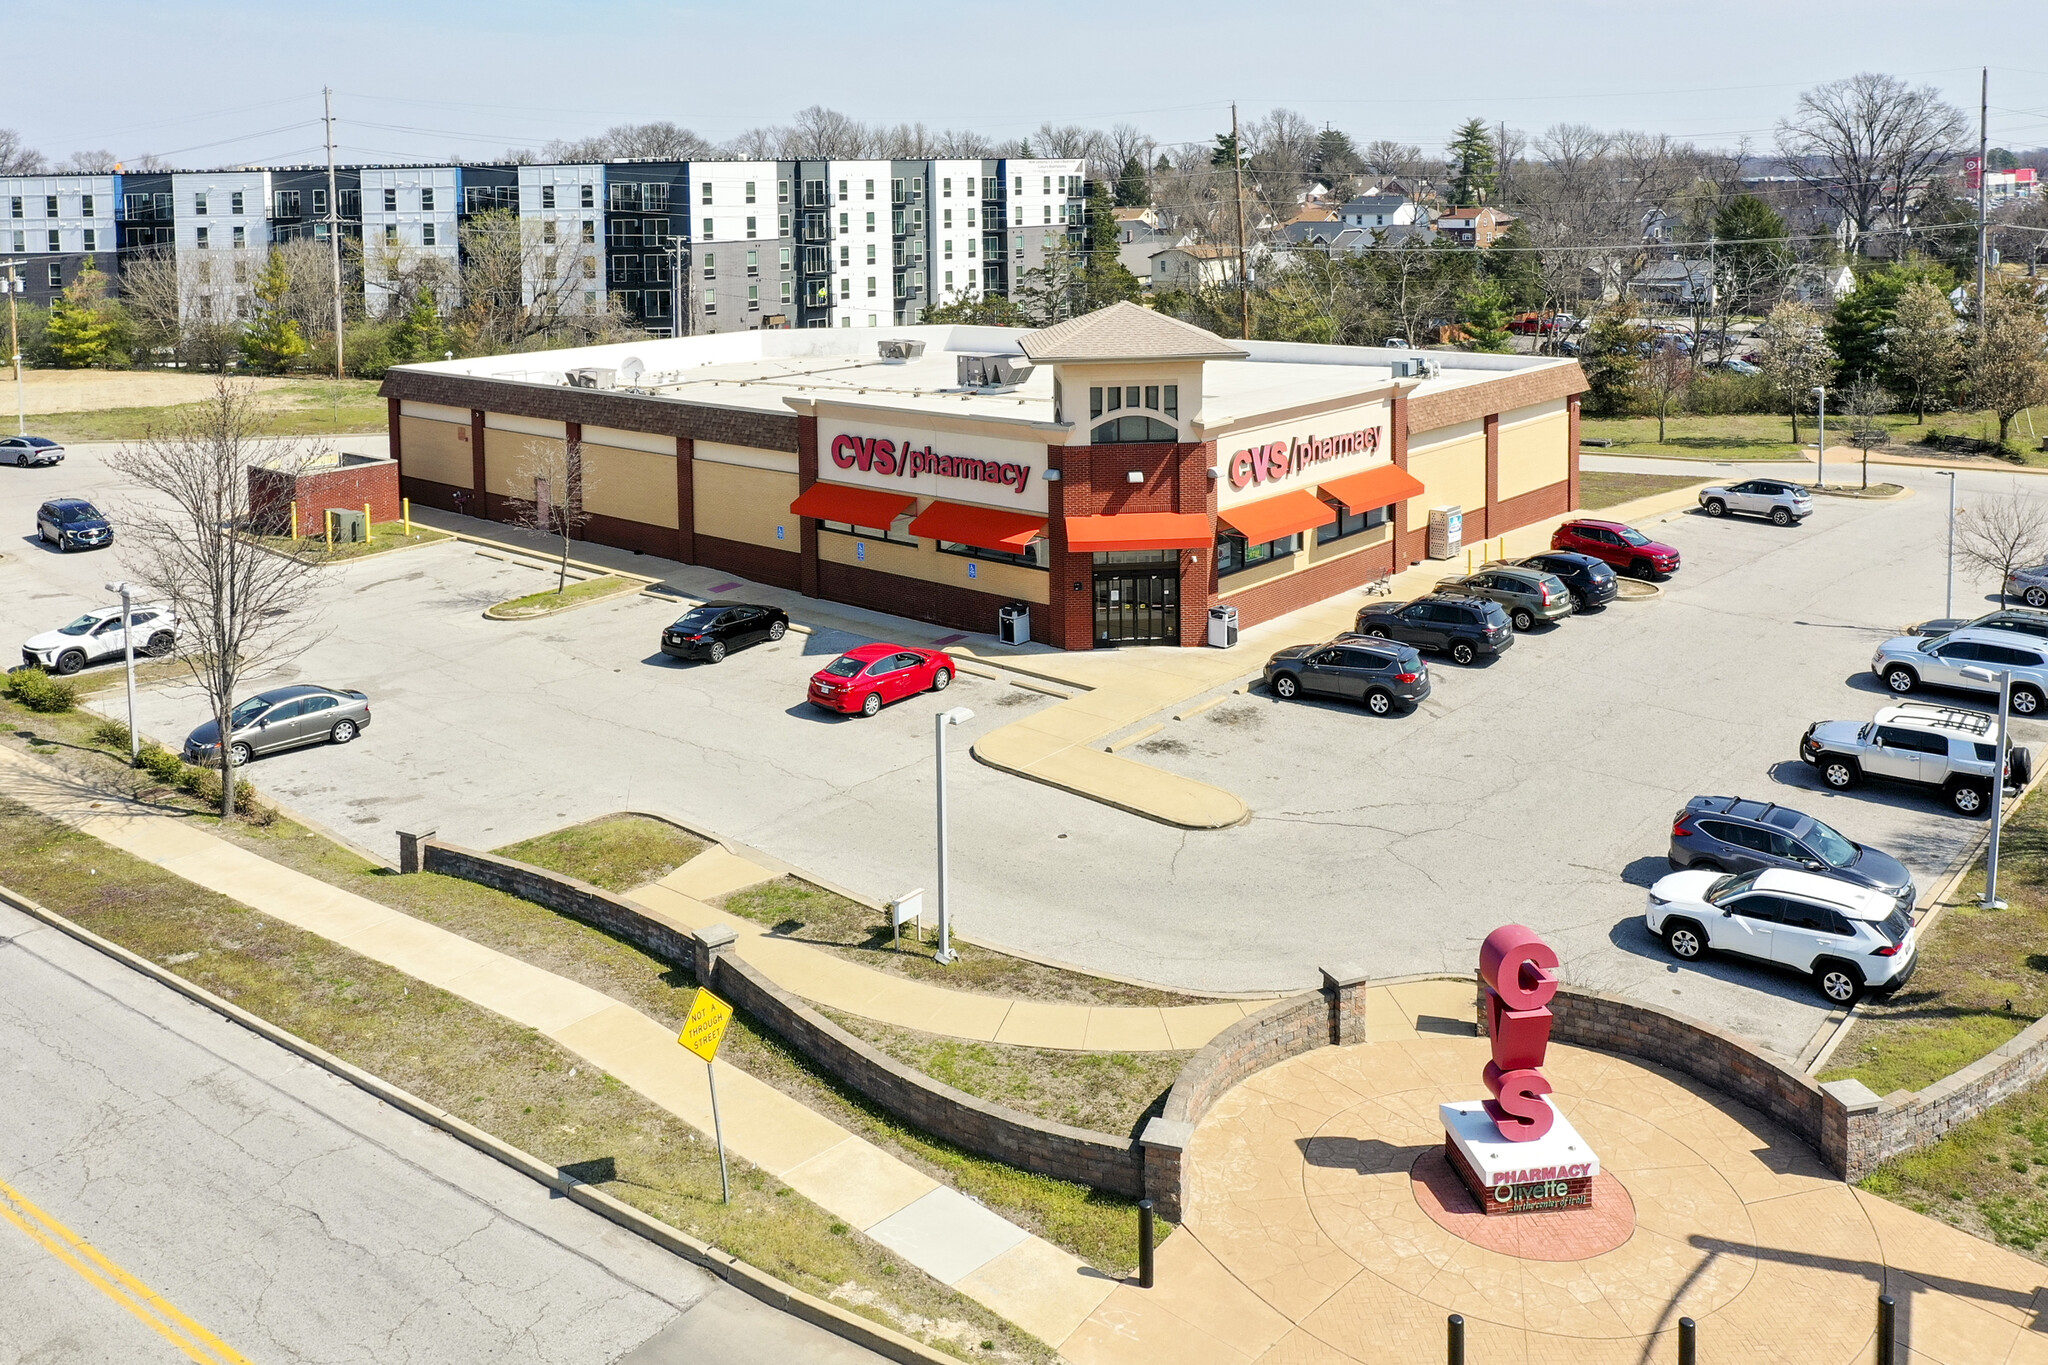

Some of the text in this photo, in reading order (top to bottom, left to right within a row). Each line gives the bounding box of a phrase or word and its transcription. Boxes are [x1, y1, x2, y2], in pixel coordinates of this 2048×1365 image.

[831, 434, 1031, 494] CVS/pharmacy
[1229, 426, 1383, 488] CVS/pharmacy
[691, 1004, 716, 1023] NOT A
[688, 1013, 723, 1039] THROUGH
[694, 1028, 721, 1050] STREET
[1493, 1163, 1592, 1185] PHARMACY
[1494, 1180, 1569, 1203] Olivette
